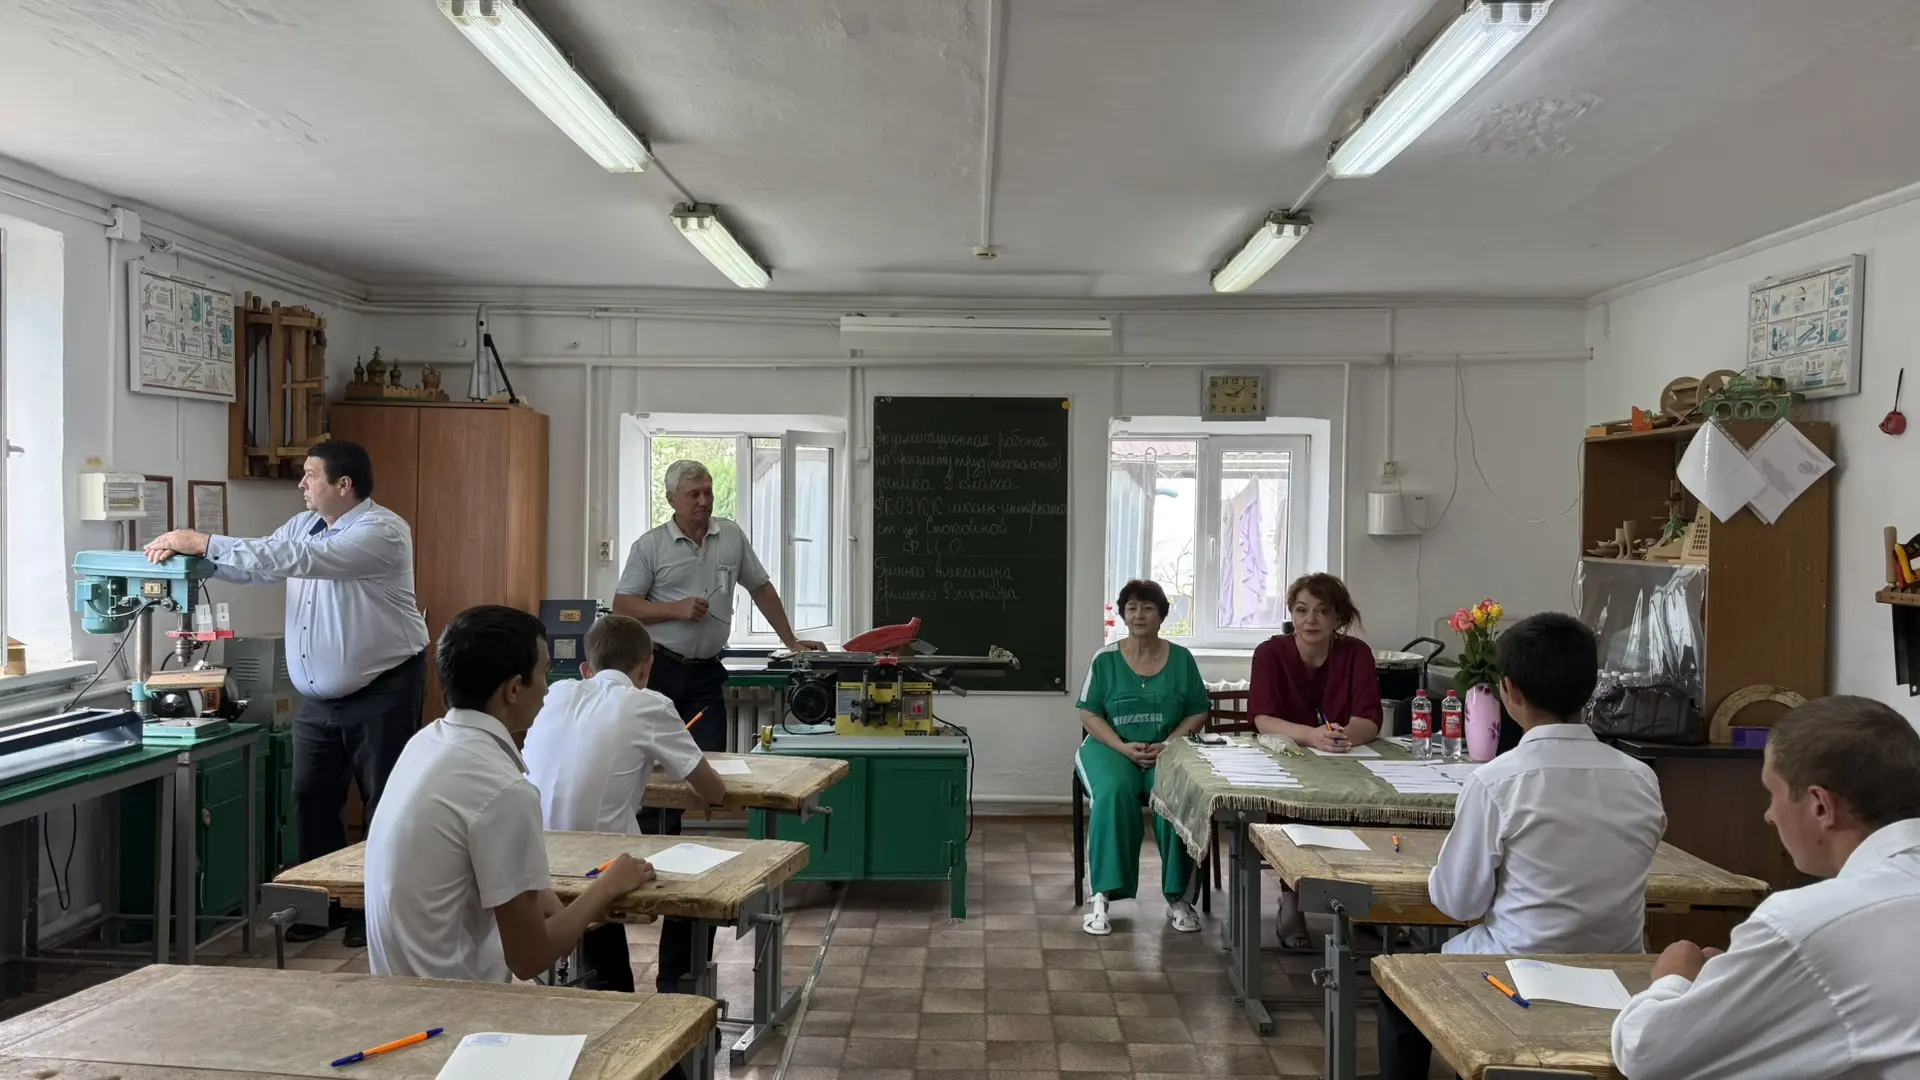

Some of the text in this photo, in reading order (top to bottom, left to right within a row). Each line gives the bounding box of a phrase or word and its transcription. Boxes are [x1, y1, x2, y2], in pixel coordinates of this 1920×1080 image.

[998, 428, 1050, 459] работа
[875, 476, 935, 494] ученика
[958, 477, 1021, 491] класса
[925, 515, 1008, 536] Спокойной
[930, 556, 1015, 588] Александра
[943, 581, 1021, 611] Виктора
